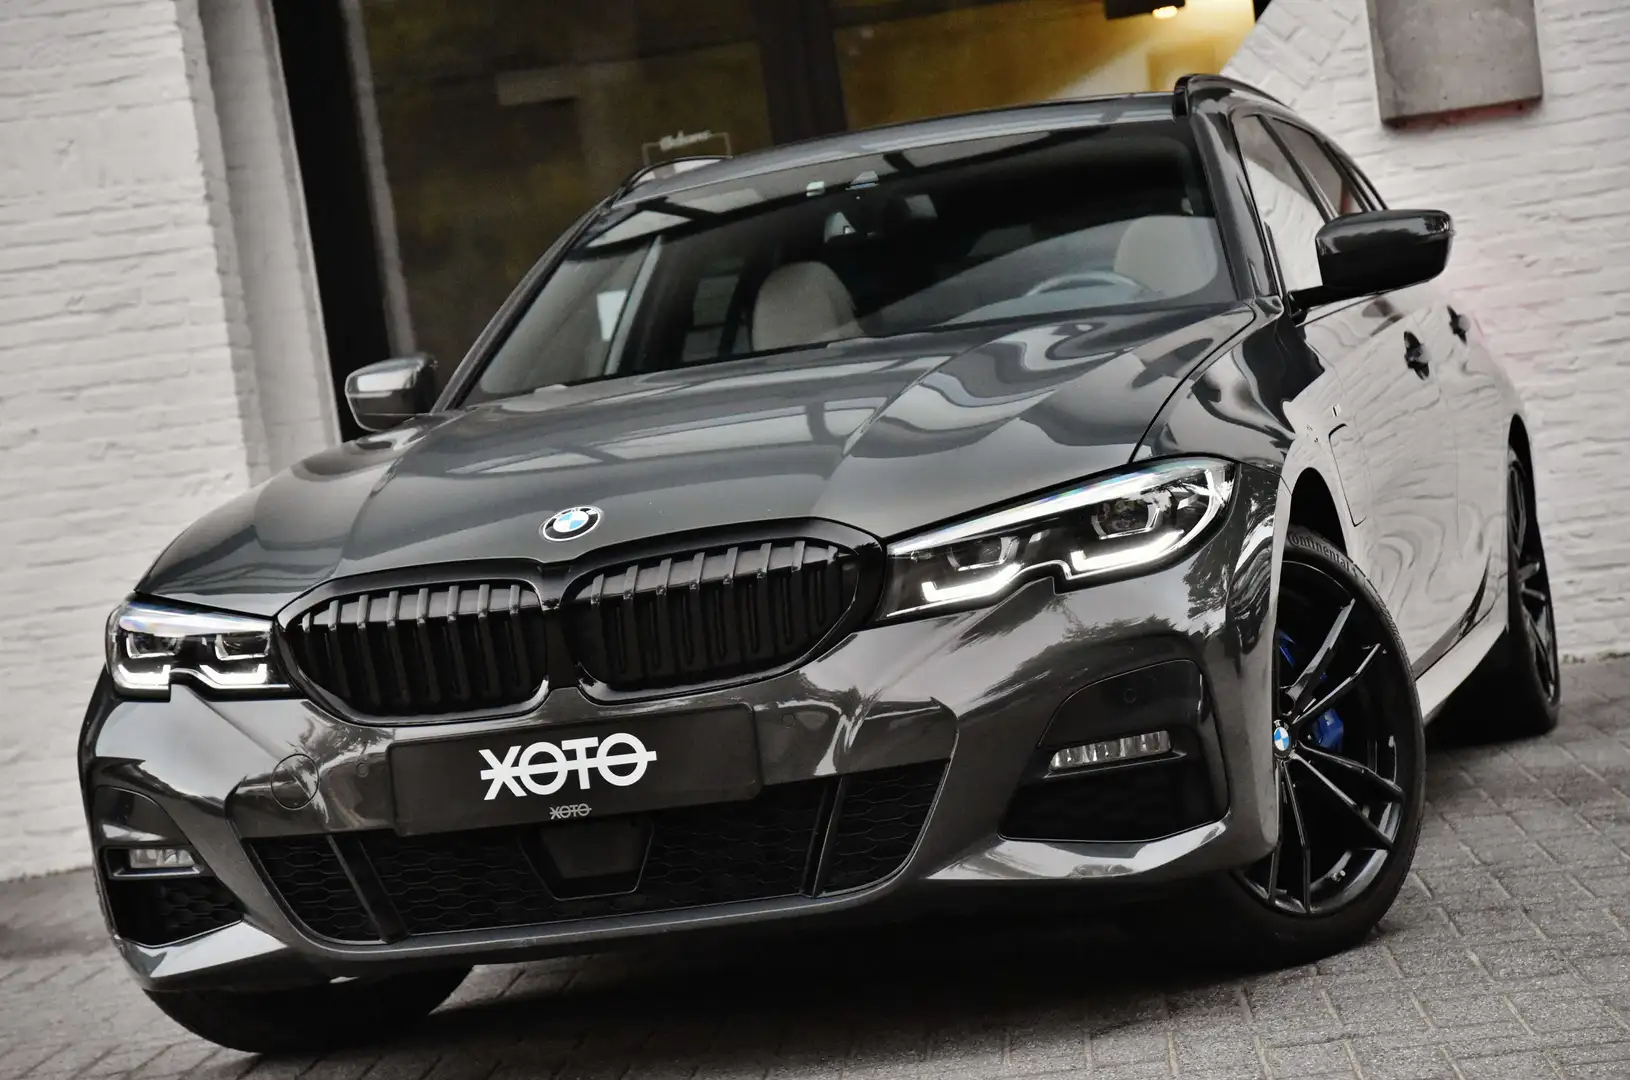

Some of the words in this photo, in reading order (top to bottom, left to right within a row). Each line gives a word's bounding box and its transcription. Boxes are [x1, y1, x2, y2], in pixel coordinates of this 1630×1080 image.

[1287, 531, 1350, 572] Continental
[478, 732, 658, 801] XOTO
[549, 803, 592, 820] XOTO
